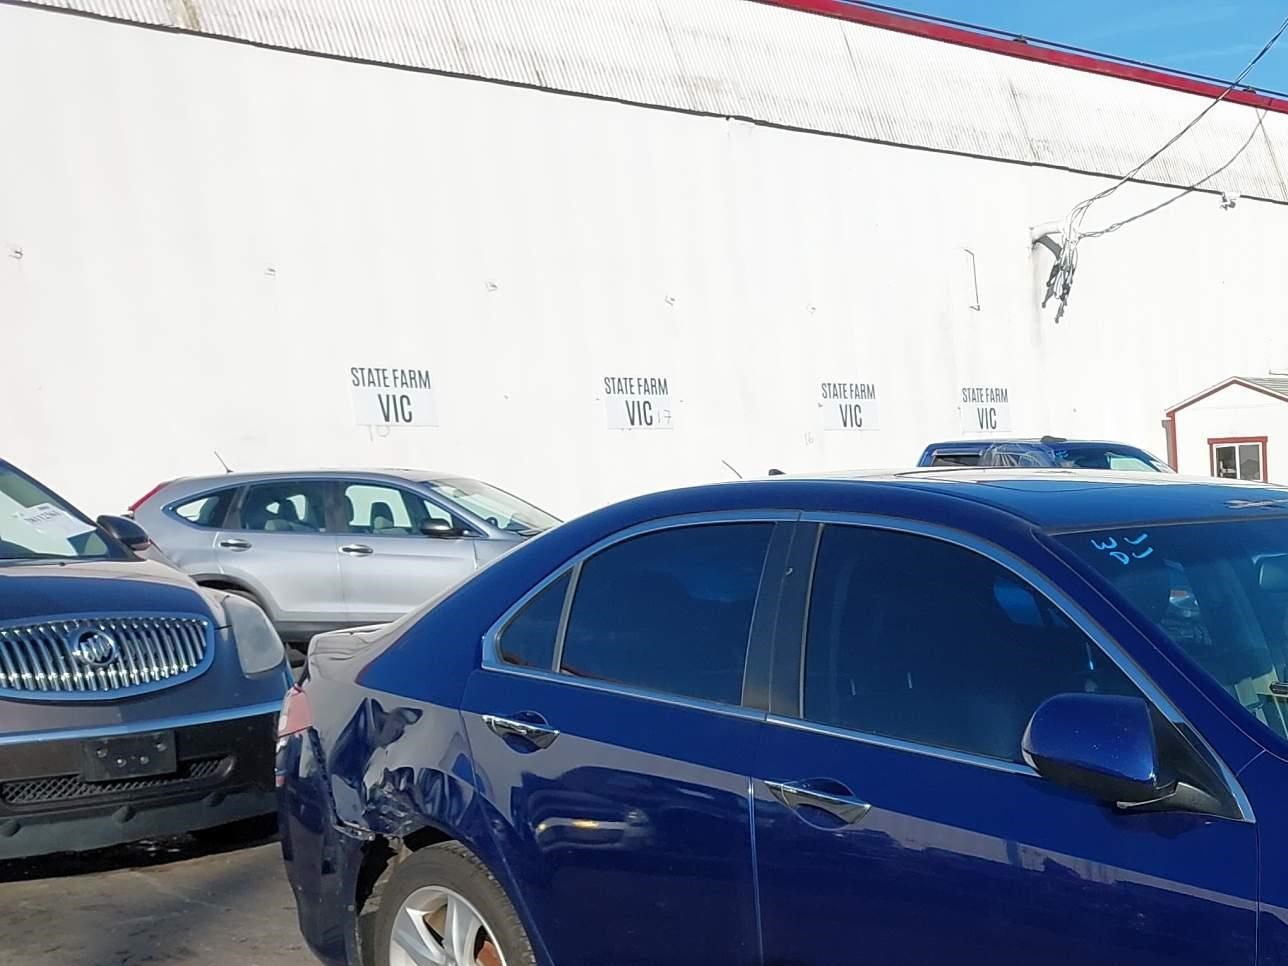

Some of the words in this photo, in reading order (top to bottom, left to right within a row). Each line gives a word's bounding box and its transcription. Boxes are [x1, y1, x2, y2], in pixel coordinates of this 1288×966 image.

[351, 367, 390, 387] STATE
[392, 369, 431, 389] FARM
[604, 377, 635, 394] STATE
[637, 378, 668, 395] FARM
[821, 382, 848, 399] STATE
[849, 383, 876, 400] FARM
[962, 387, 984, 403] STATE
[985, 387, 1008, 403] FARM
[378, 394, 413, 423] VIC
[625, 400, 653, 426] VIC
[839, 403, 862, 428] VIC
[977, 407, 997, 430] VIC
